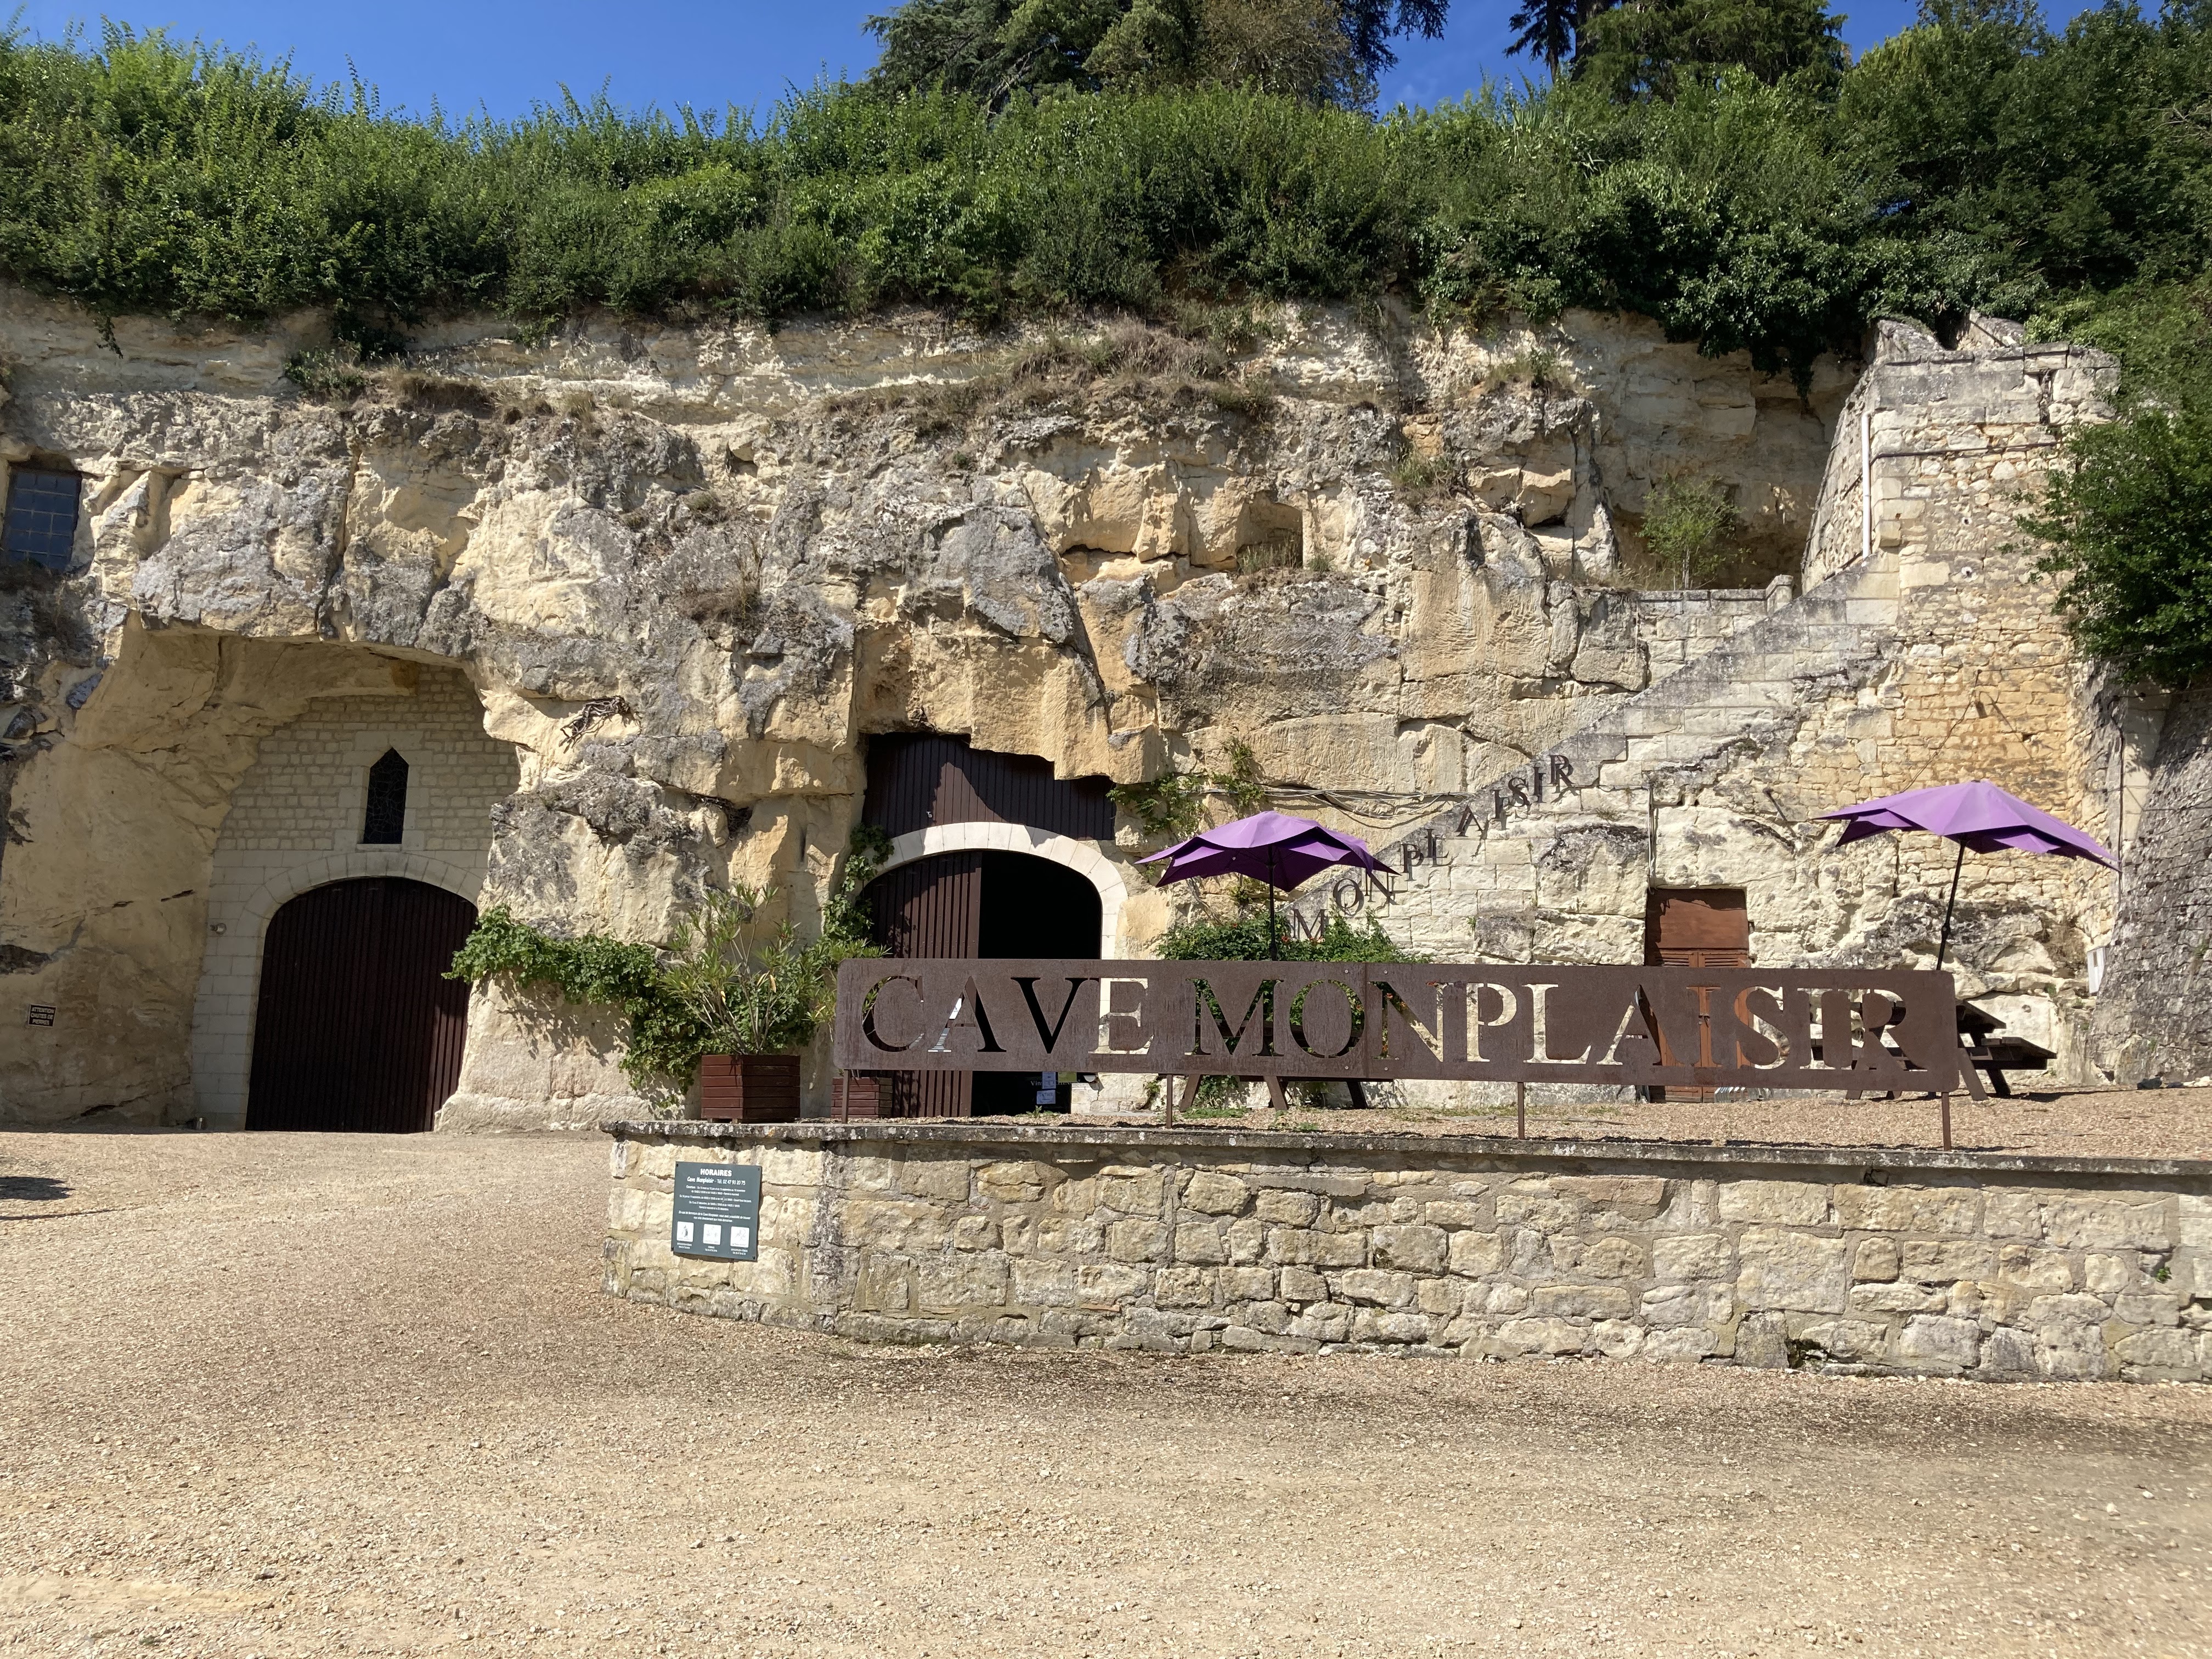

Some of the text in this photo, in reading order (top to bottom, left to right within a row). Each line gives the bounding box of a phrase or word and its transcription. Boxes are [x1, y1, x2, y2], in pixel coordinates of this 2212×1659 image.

[862, 974, 1929, 1071] CAVE MONPLAISIR
[700, 1168, 732, 1177] HORAIRES
